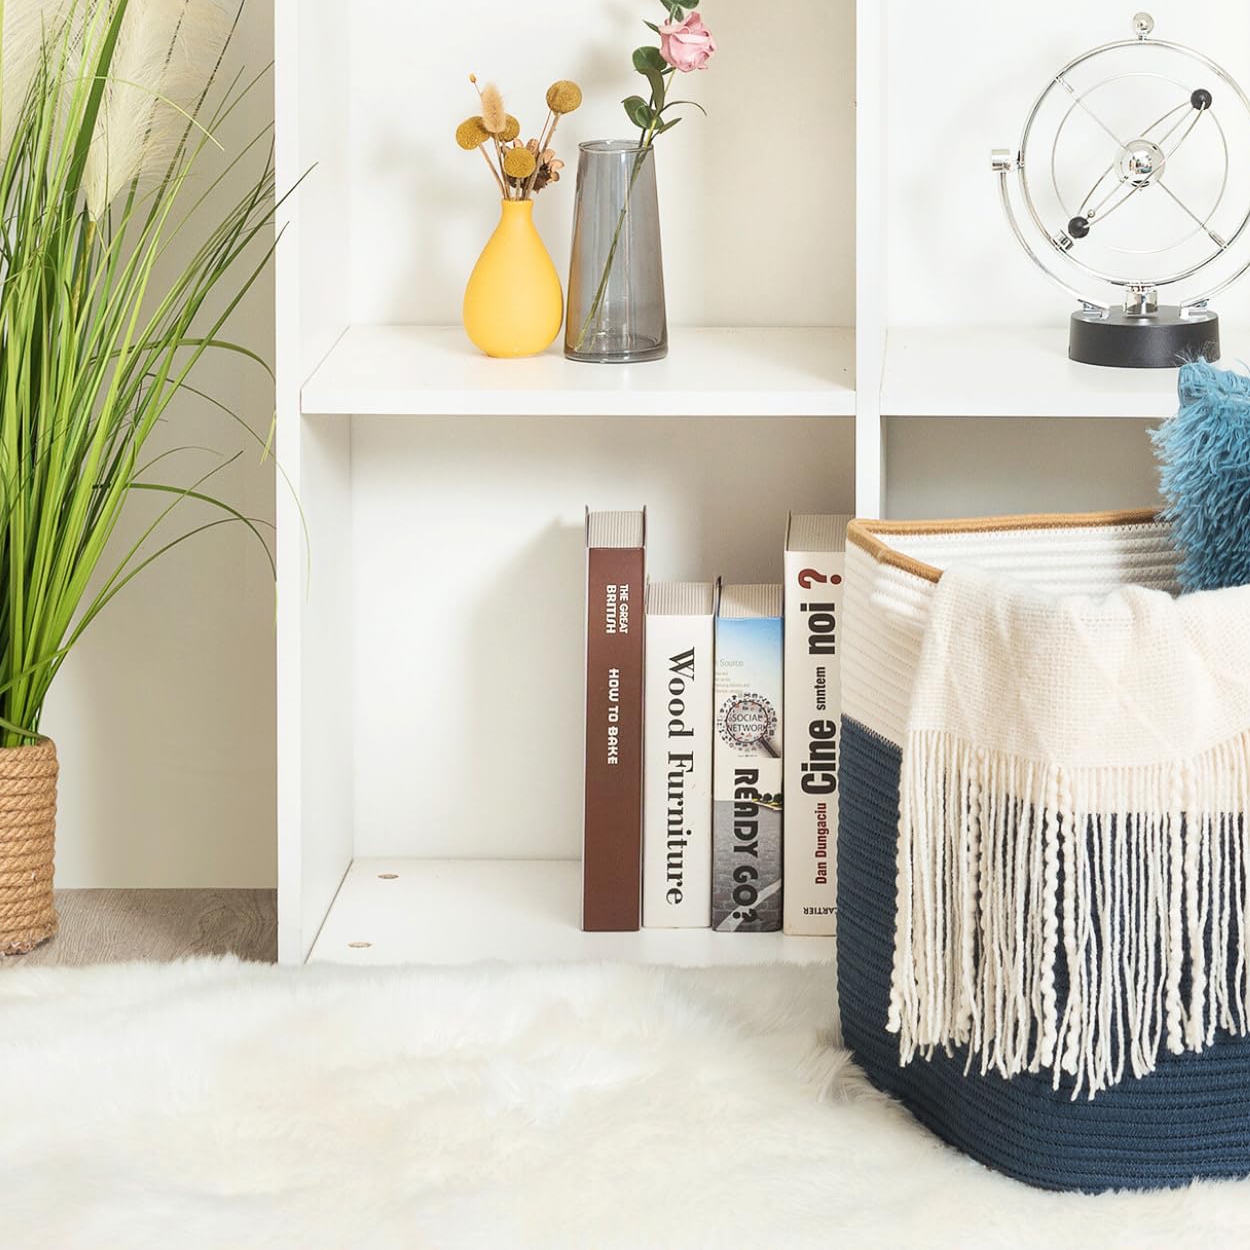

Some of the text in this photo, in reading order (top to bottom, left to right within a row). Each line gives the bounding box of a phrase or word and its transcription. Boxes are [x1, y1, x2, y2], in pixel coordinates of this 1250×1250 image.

[797, 568, 842, 589] ?
[606, 584, 616, 634] BRITISH
[619, 584, 628, 634] THE GREAT
[800, 602, 836, 655] noi
[607, 669, 619, 764] HOW TO BAKE
[732, 714, 762, 722] SOCIAL
[666, 646, 695, 905] Wood Furniture
[800, 720, 836, 795] Cine
[733, 769, 759, 858] READY
[815, 802, 829, 884] Dan Dungaciu
[733, 865, 758, 923] GO?
